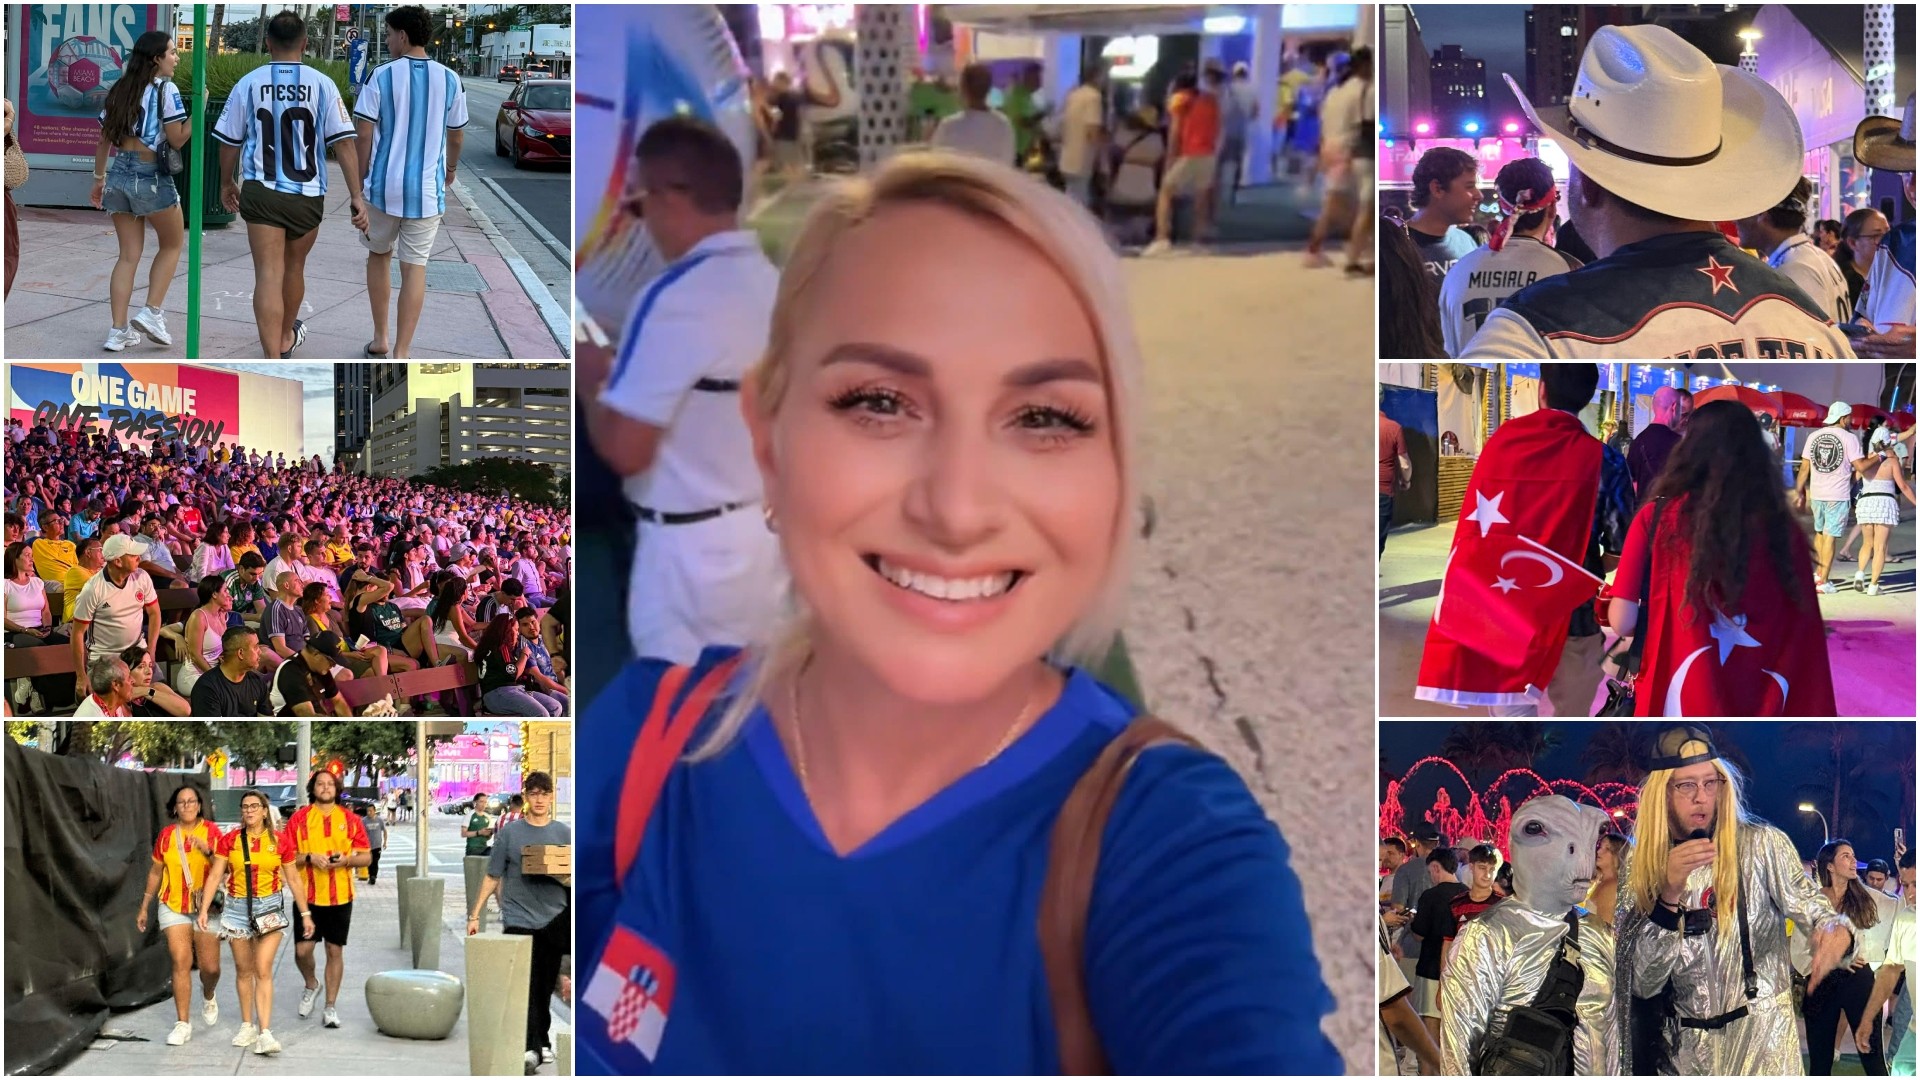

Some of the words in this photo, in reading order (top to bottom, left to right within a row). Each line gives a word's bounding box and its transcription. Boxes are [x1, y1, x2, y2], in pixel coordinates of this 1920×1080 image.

[41, 4, 136, 65] FANS
[260, 84, 312, 102] MESSI
[256, 106, 317, 182] 10
[1468, 270, 1537, 288] MUSIALA
[72, 370, 124, 406] ONE
[128, 380, 196, 416] GAME
[33, 400, 103, 433] ONE
